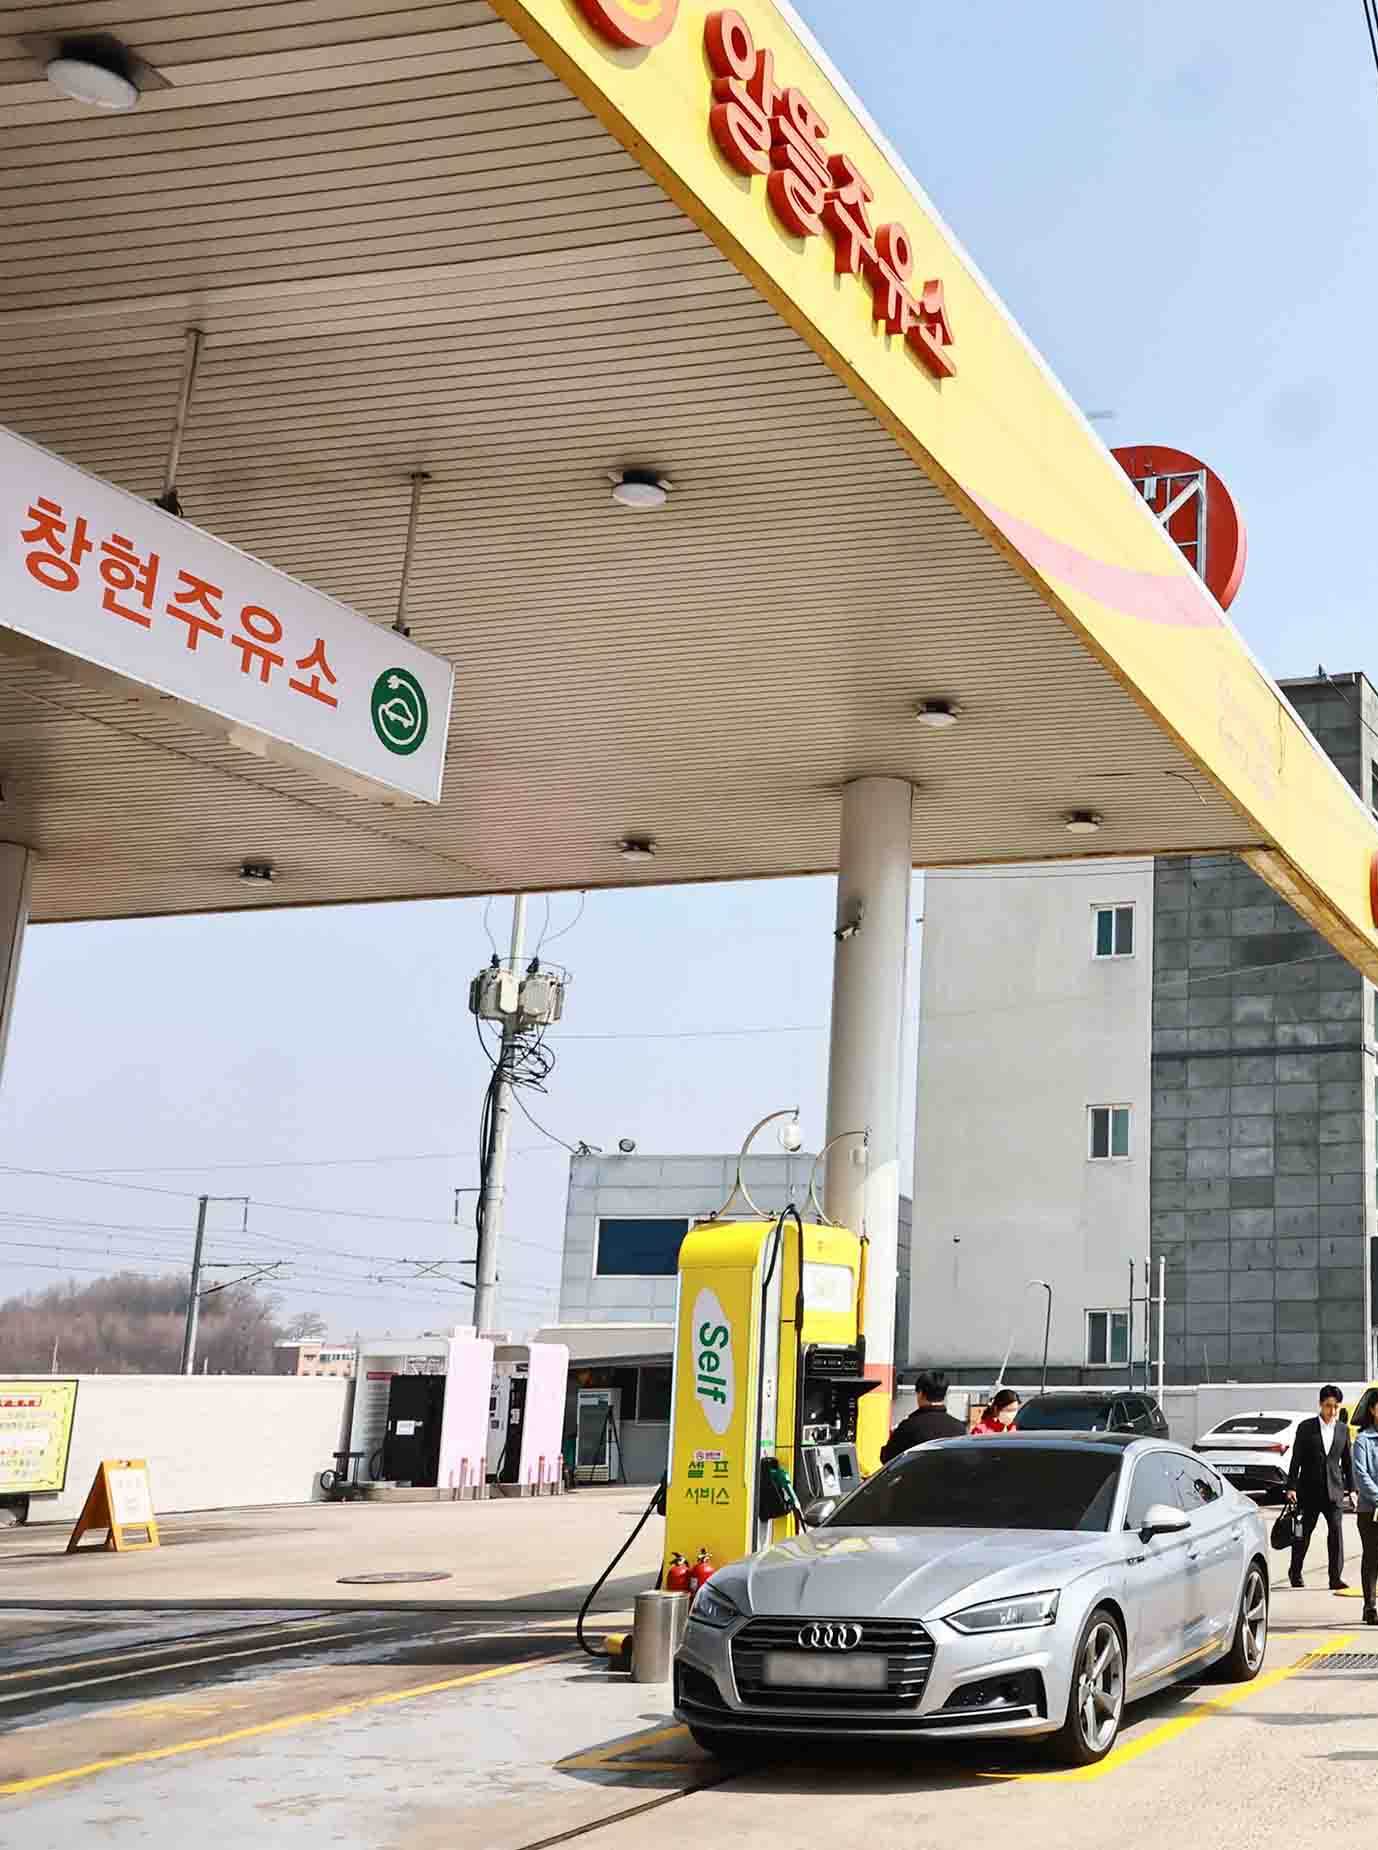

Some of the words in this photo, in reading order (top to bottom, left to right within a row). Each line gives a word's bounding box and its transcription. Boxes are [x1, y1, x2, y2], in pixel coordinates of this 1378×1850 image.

[20, 496, 338, 710] 창현주유소
[697, 1322, 729, 1404] Self
[687, 1461, 729, 1478] 셀프
[684, 1487, 730, 1505] 서비스
